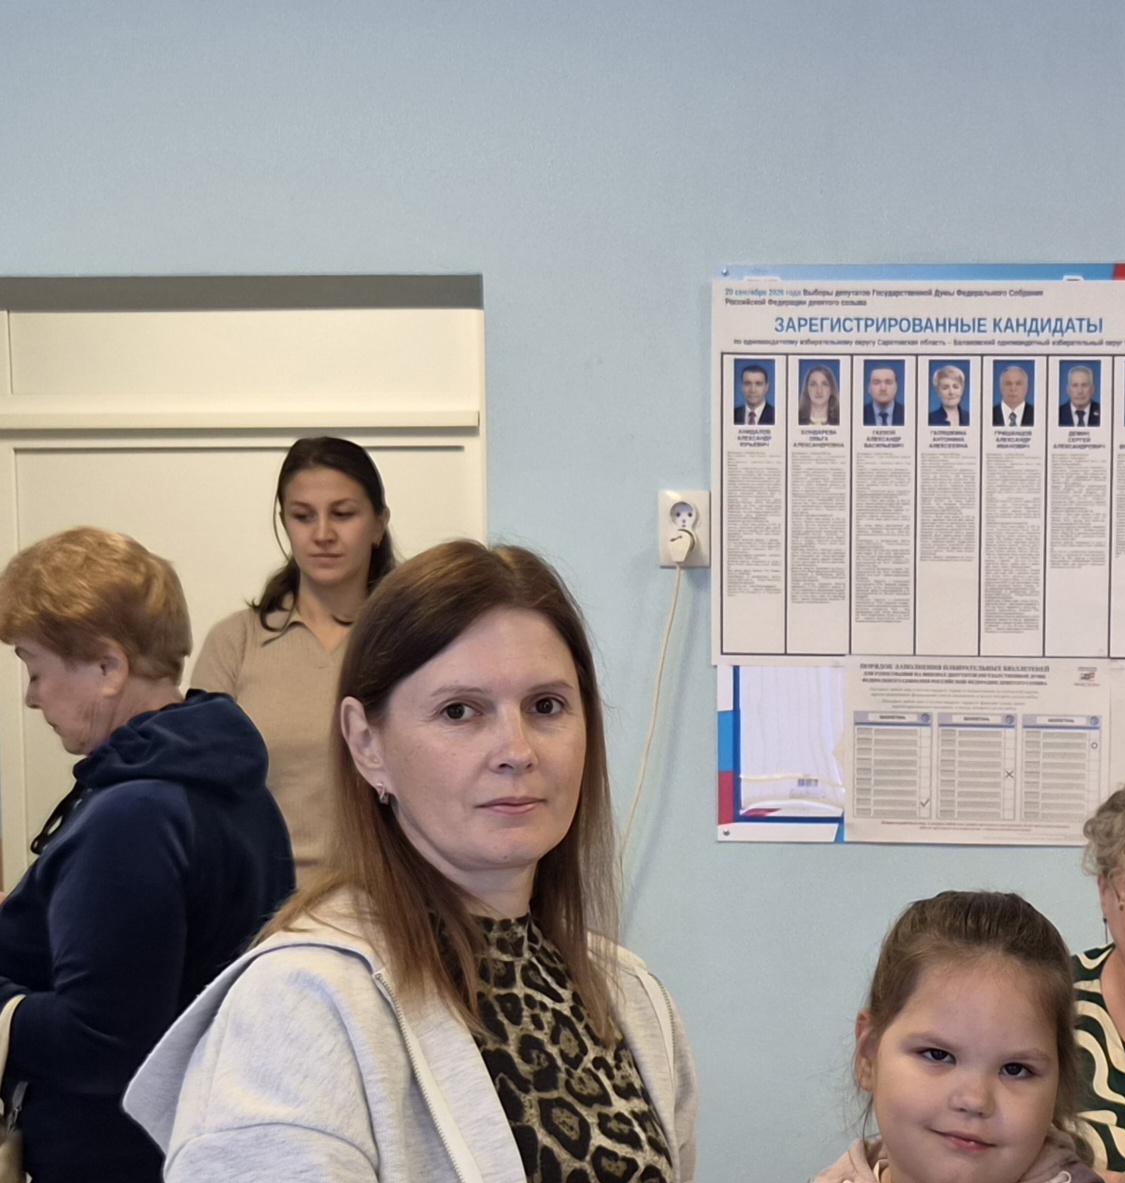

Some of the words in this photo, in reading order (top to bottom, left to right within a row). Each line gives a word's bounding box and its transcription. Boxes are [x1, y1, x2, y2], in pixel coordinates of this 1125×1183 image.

[803, 289, 833, 297] Выборы
[774, 317, 987, 333] ЗАРЕГИСТРИРОВАННЫЕ
[992, 317, 1103, 337] КАНДИДАТЫ
